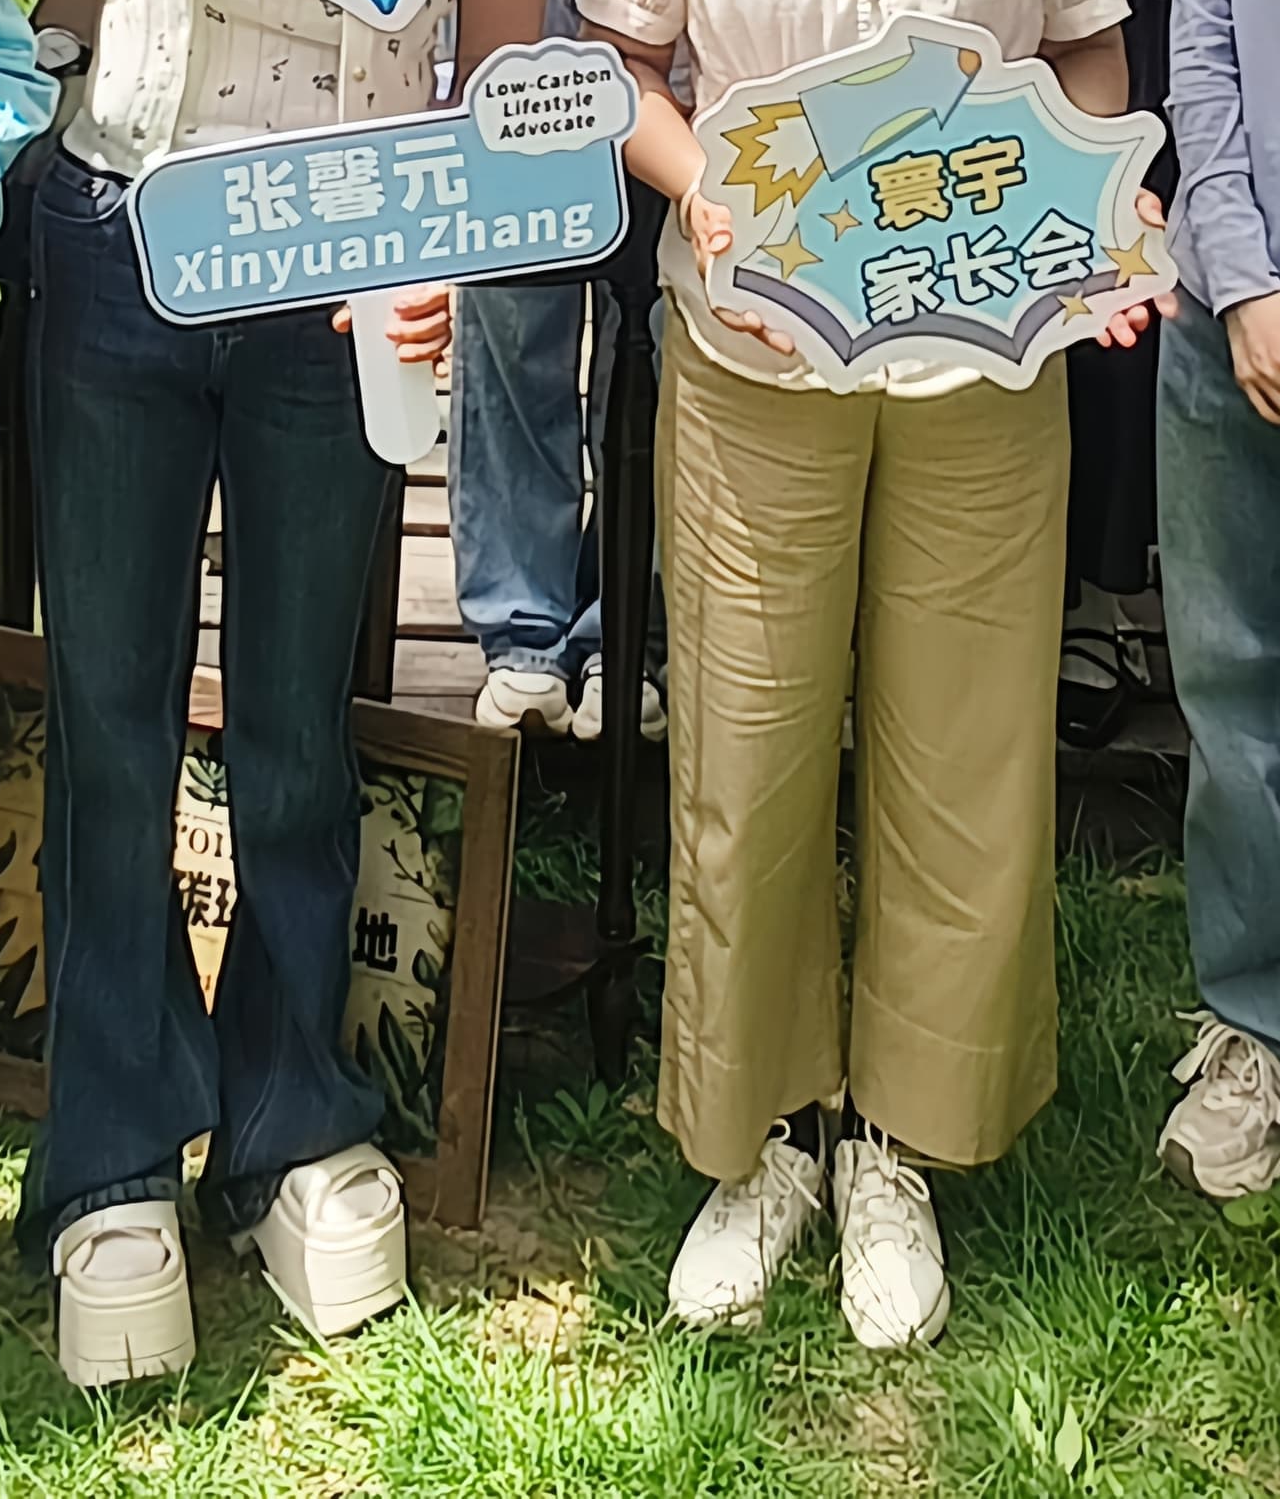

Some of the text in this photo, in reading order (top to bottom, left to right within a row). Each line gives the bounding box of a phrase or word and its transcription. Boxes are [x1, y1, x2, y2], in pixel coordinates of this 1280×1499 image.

[486, 69, 611, 98] Low-Carbon
[500, 115, 596, 140] Advocate
[503, 92, 593, 118] Lifestyle
[223, 133, 469, 237] 张馨元
[867, 135, 1027, 232] 寰宇
[171, 202, 594, 299] Xinyuan Zhang
[861, 208, 1095, 328] 家长会
